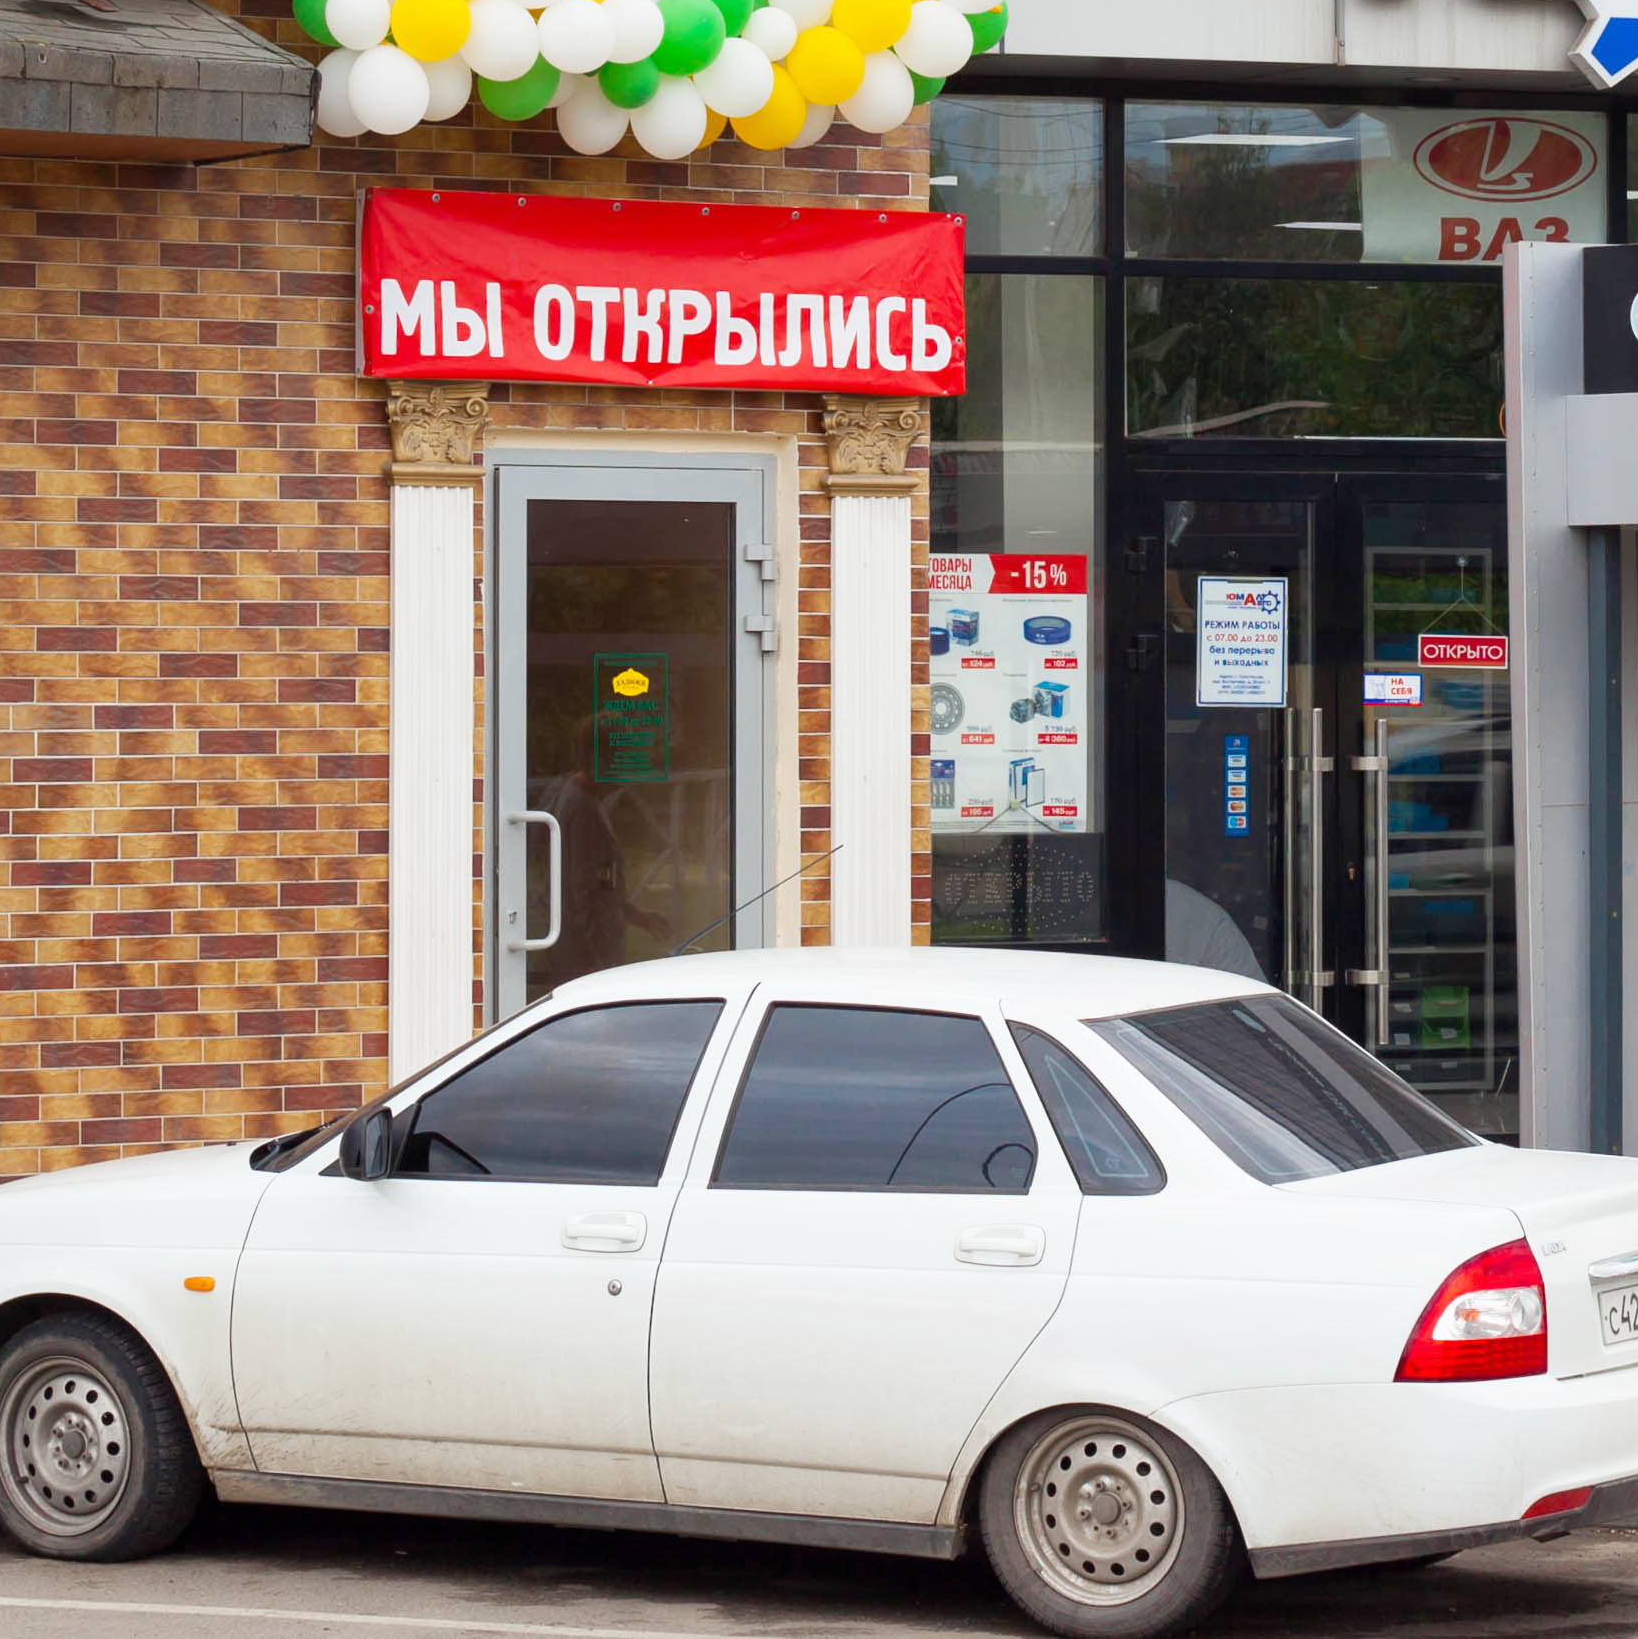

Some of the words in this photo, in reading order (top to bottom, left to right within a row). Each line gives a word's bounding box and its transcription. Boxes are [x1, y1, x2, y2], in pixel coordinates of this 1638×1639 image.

[1439, 216, 1571, 261] ВАЗ
[380, 278, 505, 357] МЫ
[533, 283, 954, 373] ОТКРЫЛИСЬ
[1205, 620, 1239, 629] РЕЖИМ
[1242, 620, 1280, 629] РАБОТЫ
[1241, 635, 1252, 643] до
[1209, 645, 1225, 654] без
[1228, 647, 1275, 656] перерыва
[1423, 644, 1503, 660] ОТКРЫТО
[1390, 687, 1412, 695] СЕБЯ
